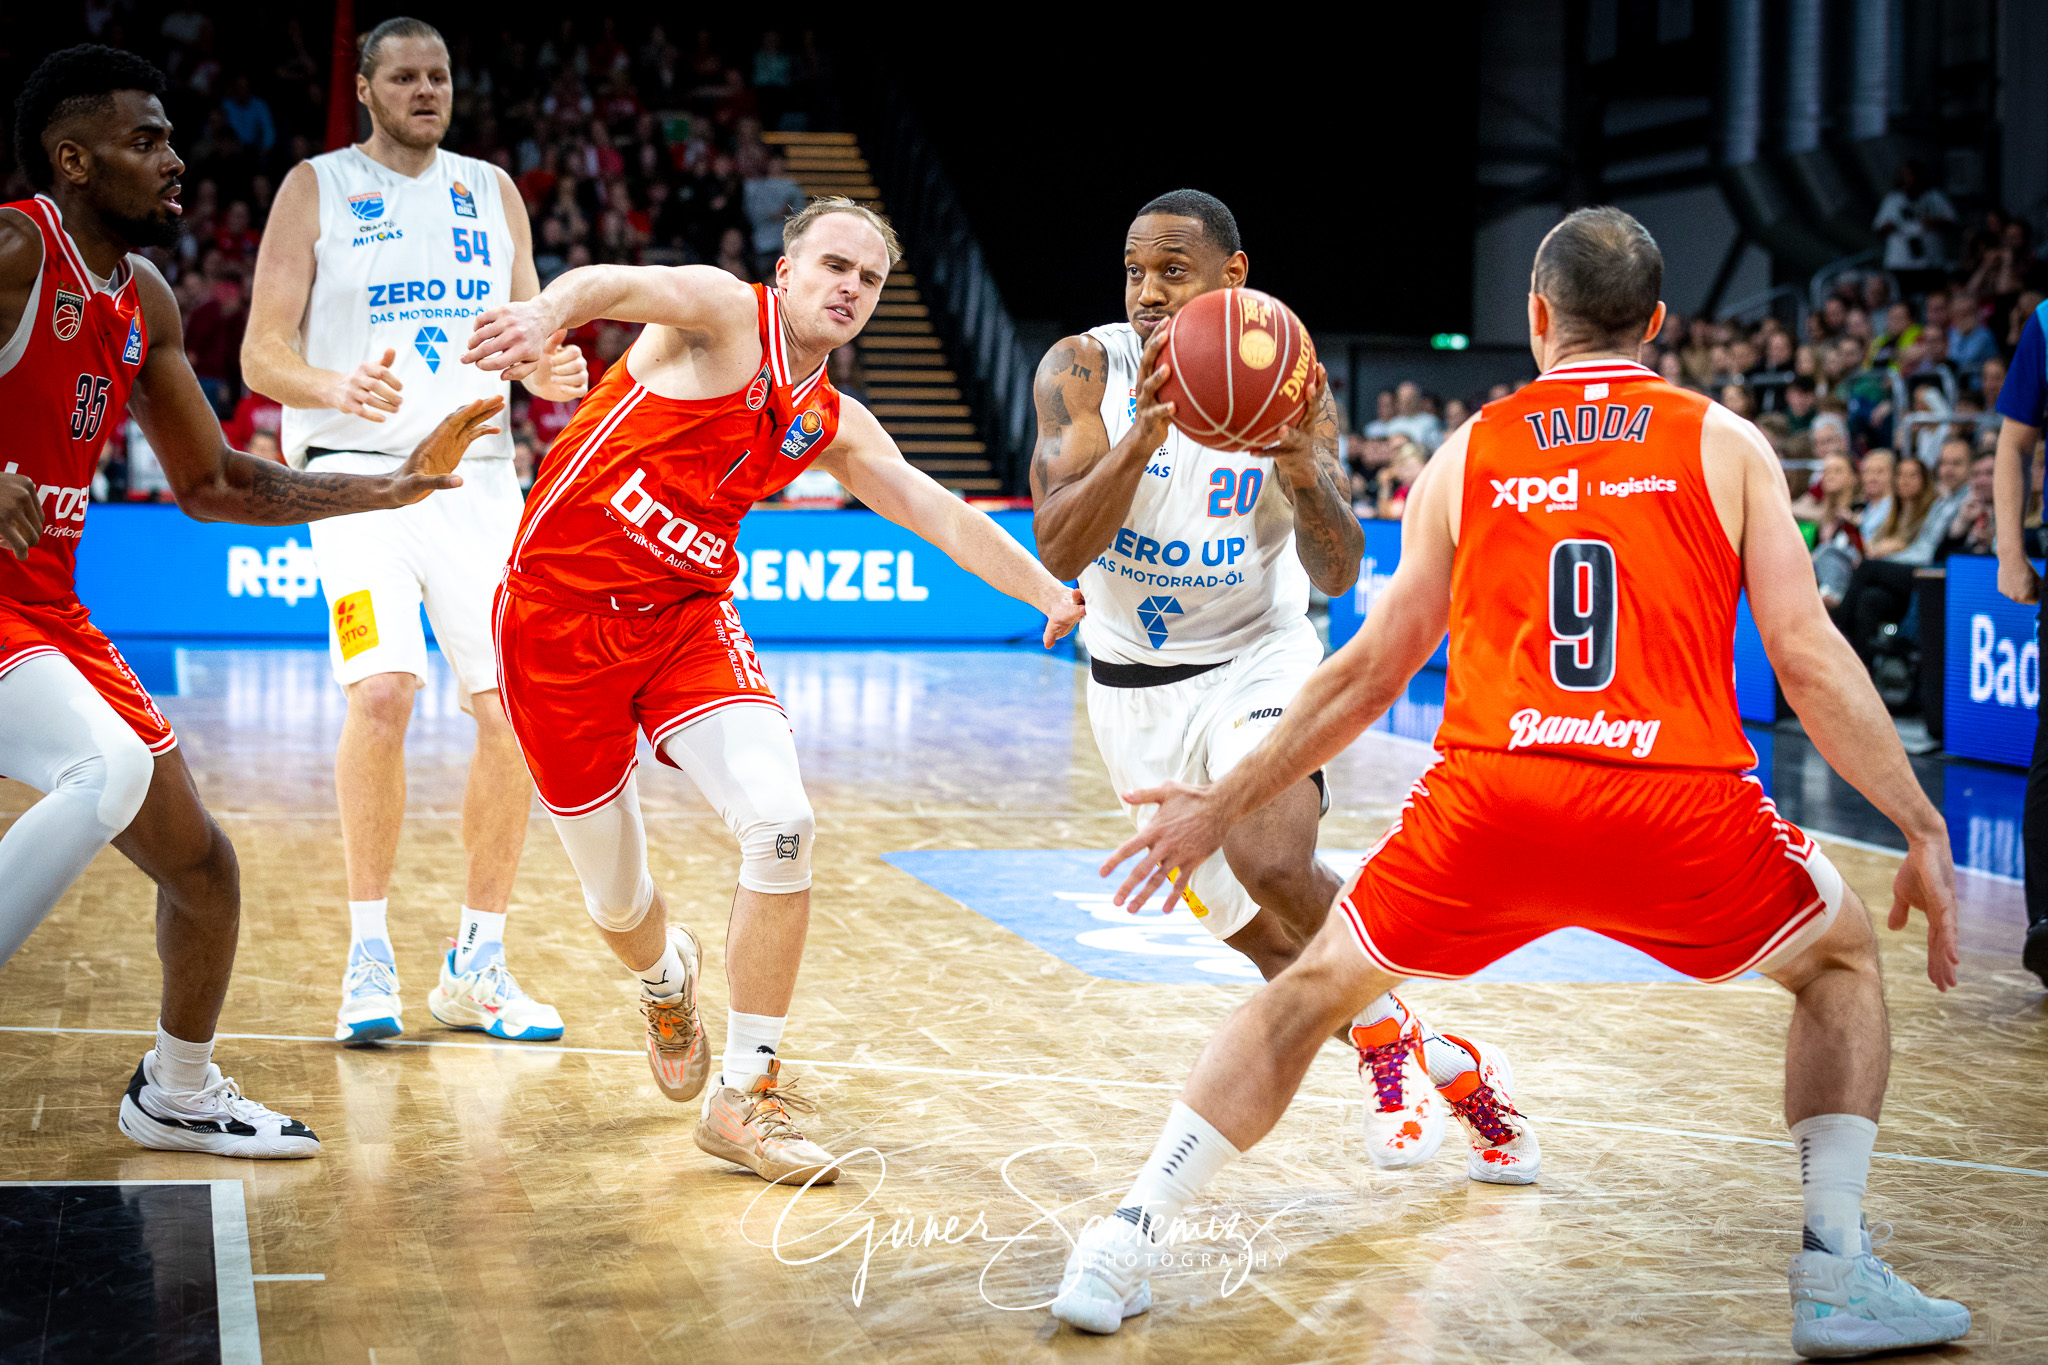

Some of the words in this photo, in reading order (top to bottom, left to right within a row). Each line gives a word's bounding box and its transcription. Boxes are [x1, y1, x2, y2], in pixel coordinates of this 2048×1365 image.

[353, 229, 403, 247] MITGAS
[452, 227, 491, 267] 54
[368, 279, 446, 307] ZERO
[456, 278, 490, 301] UP
[370, 311, 395, 325] DAS
[71, 373, 112, 441] 35
[1524, 404, 1654, 450] TADDA
[781, 439, 802, 456] BBL
[1207, 468, 1264, 519] 20
[1490, 468, 1579, 512] xpd
[1600, 475, 1677, 498] logistics
[609, 467, 726, 569] brose
[1106, 528, 1190, 567] ERO
[1201, 536, 1246, 567] UP
[1120, 565, 1245, 588] MOTORRAD-ÖL
[1548, 538, 1619, 692] 9
[340, 625, 367, 647] OTTO
[727, 649, 747, 689] KOLLEGEN
[1508, 708, 1662, 758] Bamberg
